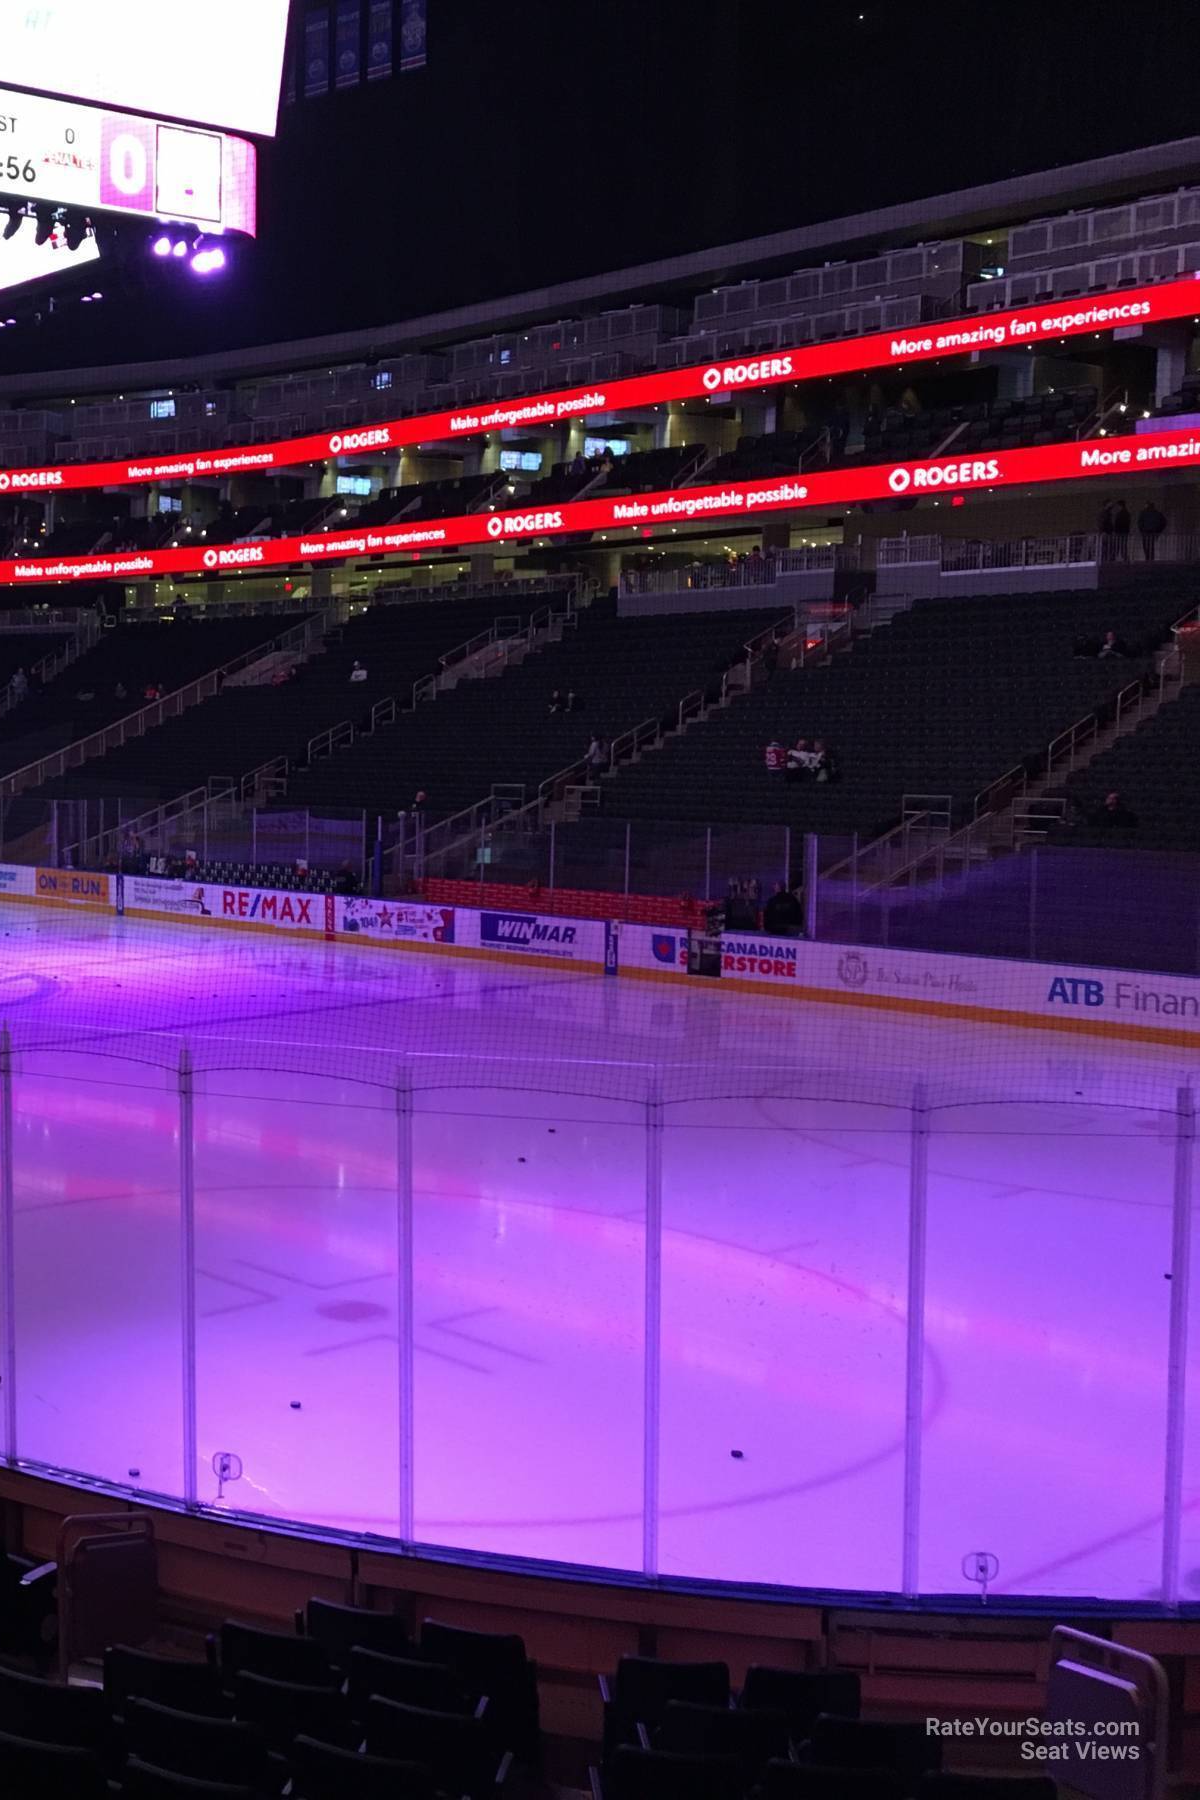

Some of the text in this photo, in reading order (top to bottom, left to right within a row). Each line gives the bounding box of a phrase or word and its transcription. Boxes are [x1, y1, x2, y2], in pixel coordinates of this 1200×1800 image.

[65, 128, 75, 144] 0
[110, 134, 147, 195] 0
[891, 302, 1150, 355] More amazing fan experiences
[723, 356, 792, 385] ROGERS
[451, 393, 605, 430] Make unforgettable possible
[343, 428, 390, 450] ROGERS
[128, 454, 273, 477] More amazing fan experiences
[1081, 450, 1131, 466] More
[12, 471, 62, 486] ROGERS
[914, 460, 998, 487] ROGERS
[614, 484, 807, 518] Make unforgettable possible
[504, 511, 562, 533] ROGERS
[300, 530, 445, 554] More amazing fan experiences
[15, 557, 153, 577] Make unforgettable possible
[219, 547, 263, 564] ROGERS
[39, 874, 58, 890] ON
[71, 877, 101, 895] RUN
[223, 890, 312, 925] RE/MAX
[497, 919, 577, 945] WINMAR
[720, 941, 797, 960] CANADIAN
[1047, 977, 1199, 1017] ATB Finan
